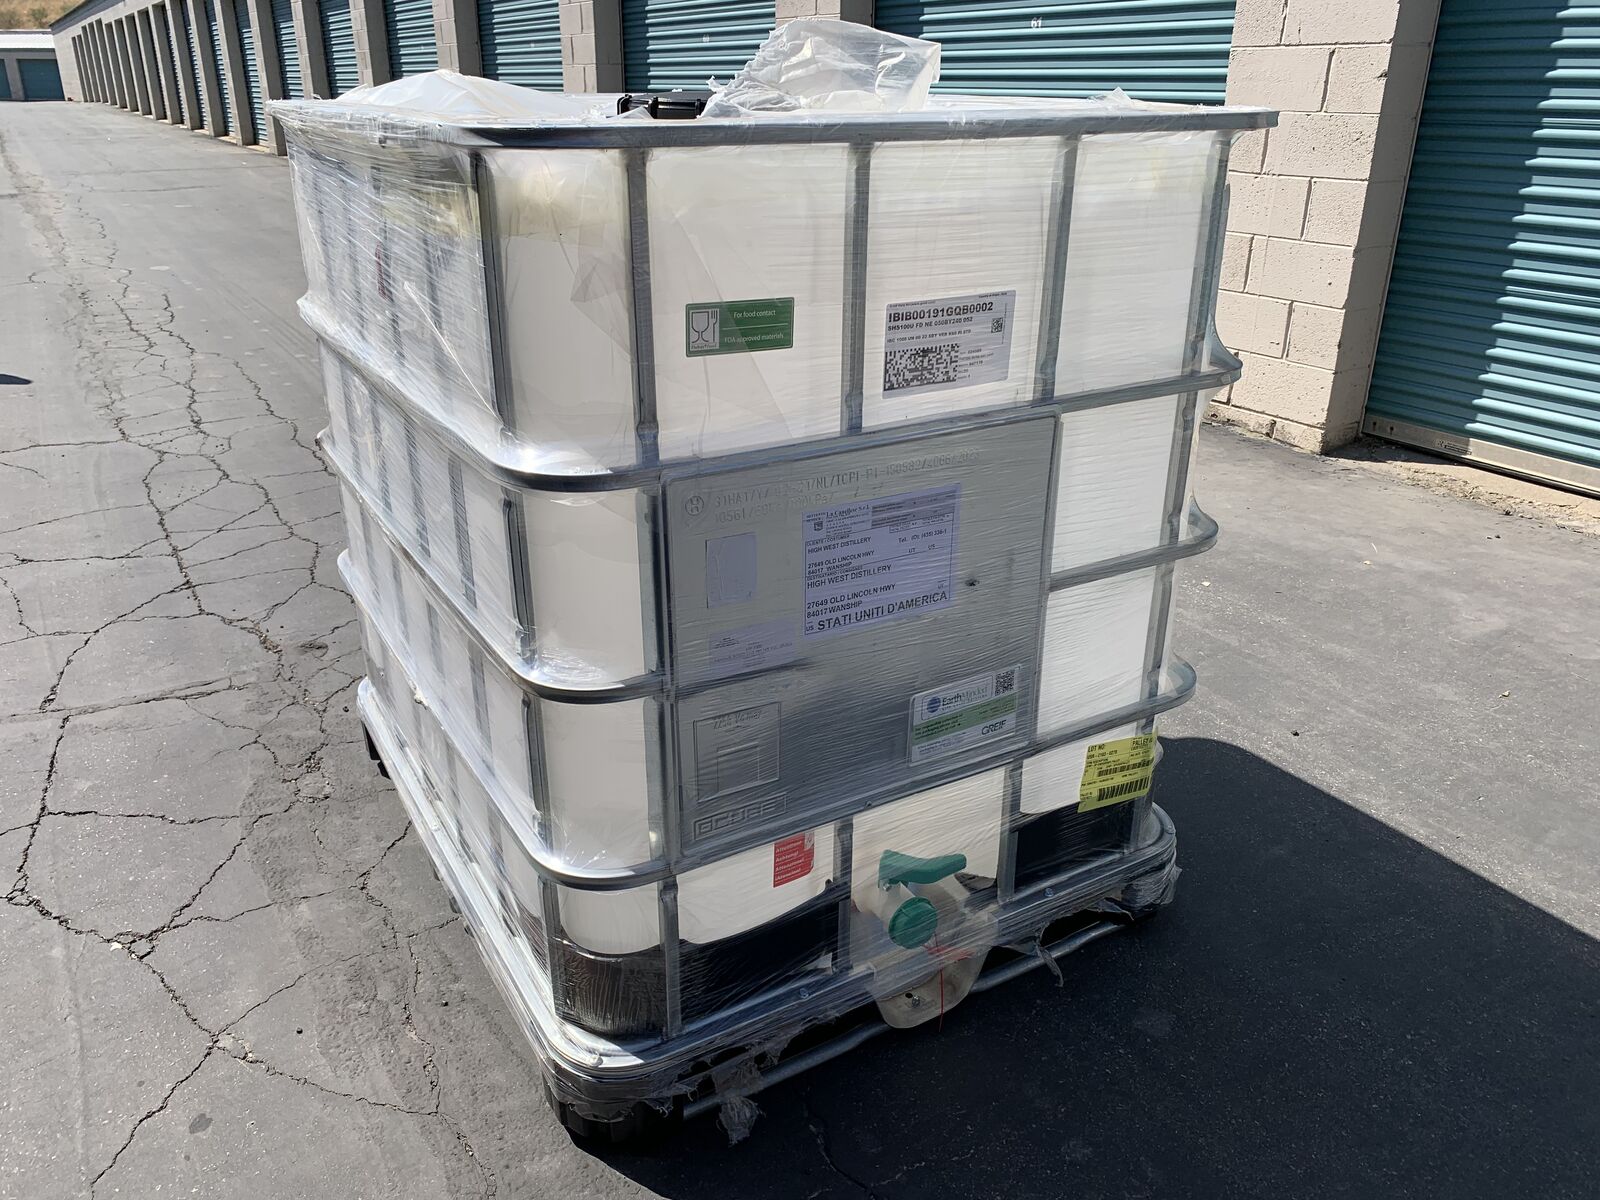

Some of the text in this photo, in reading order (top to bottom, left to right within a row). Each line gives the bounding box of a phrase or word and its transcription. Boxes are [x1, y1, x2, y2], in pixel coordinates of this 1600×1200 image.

[1031, 16, 1043, 28] 61
[888, 302, 994, 323] IBIB00191GQB0002
[736, 334, 761, 343] approved
[761, 332, 784, 341] materials
[808, 536, 871, 554] HIGH WEST DISTILLERY
[807, 561, 824, 569] 27649
[825, 558, 837, 566] OLD
[838, 553, 862, 563] LINCOLN
[827, 561, 853, 572] WANSHIP
[807, 564, 892, 589] HIGH WEST DISTILLERY
[807, 584, 896, 609] 27649 OLD LINCOLN HWY
[806, 600, 863, 619] 84017 WANSHIP
[817, 614, 852, 631] STATI
[855, 606, 884, 622] UNITI
[887, 590, 948, 614] D'AMERICA
[981, 719, 1007, 735] GREIF
